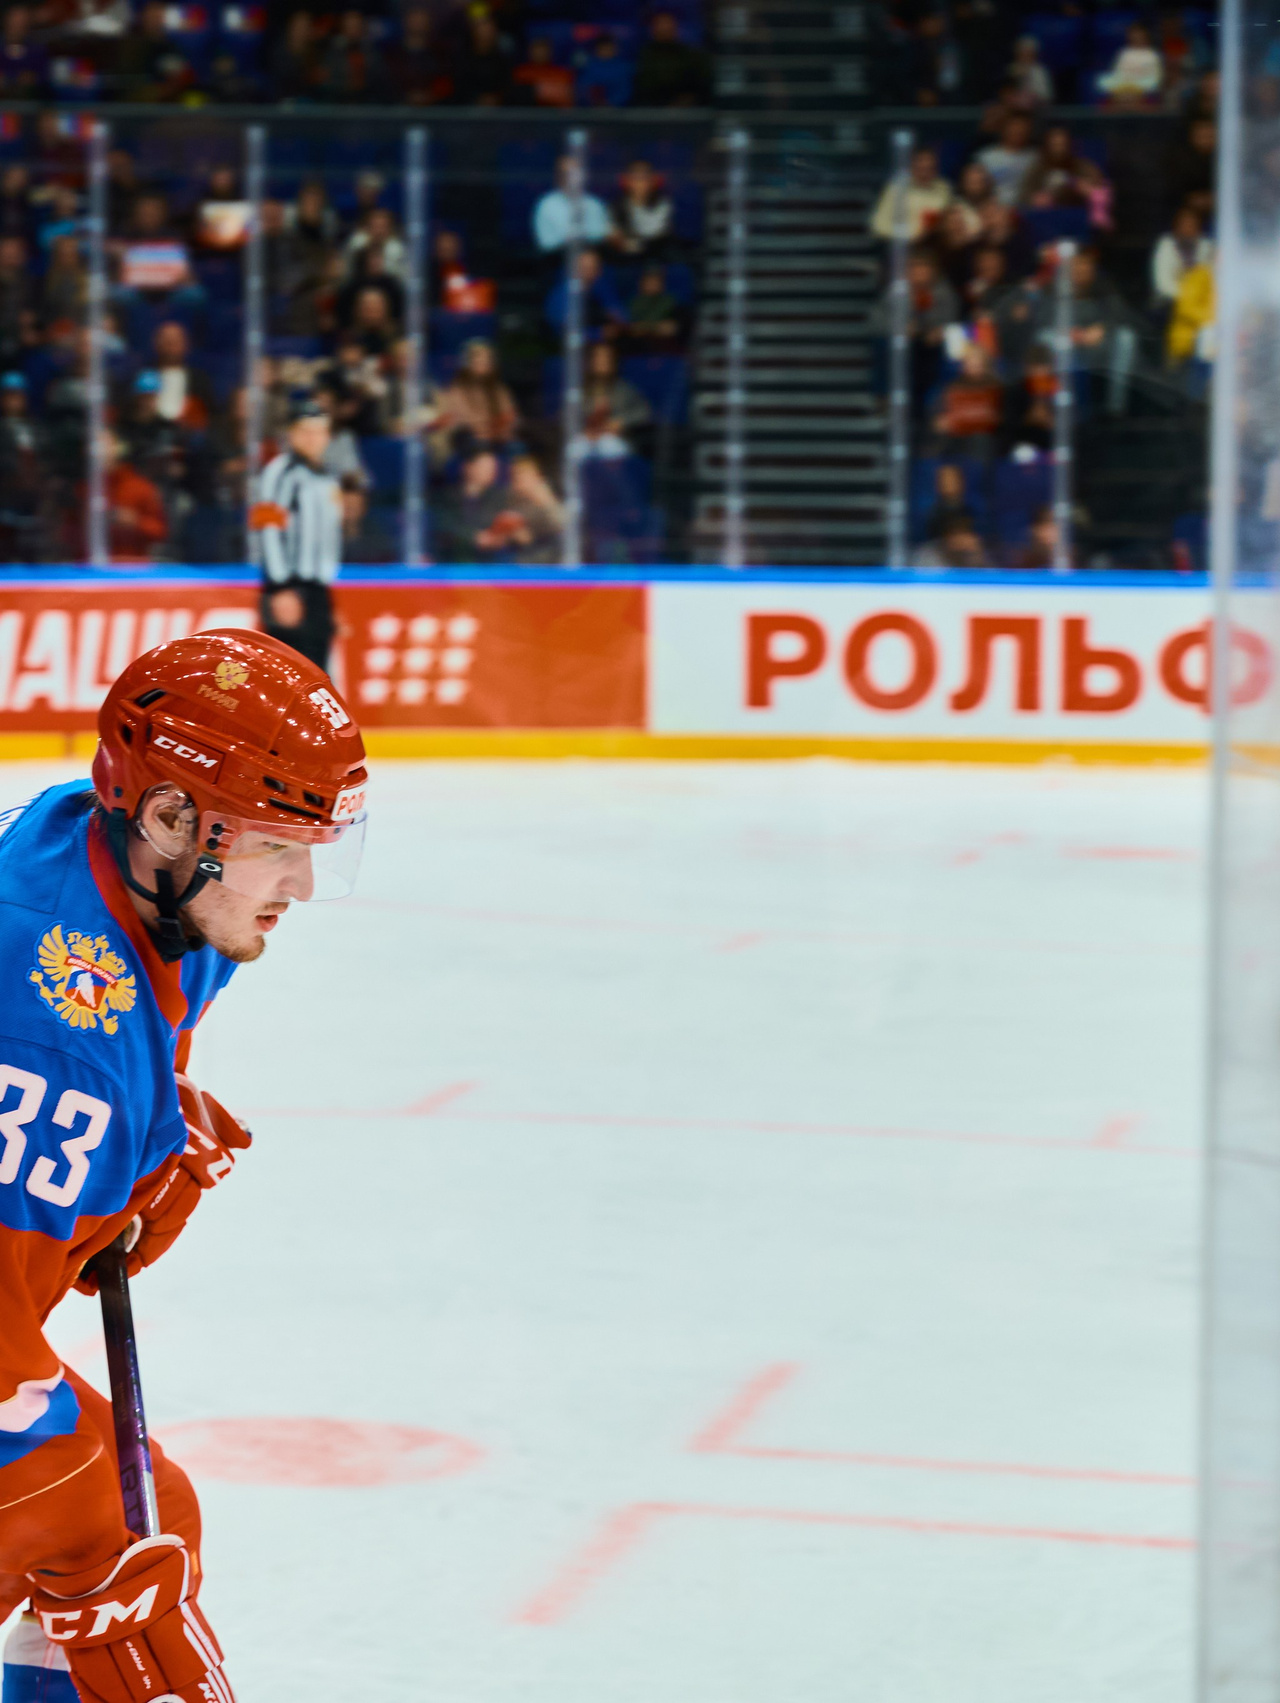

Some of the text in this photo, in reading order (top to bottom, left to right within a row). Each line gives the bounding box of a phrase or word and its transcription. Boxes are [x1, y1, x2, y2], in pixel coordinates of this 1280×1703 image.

[742, 609, 1276, 716] РОЛЬФ
[153, 734, 219, 769] CCM
[33, 1583, 161, 1641] CM
